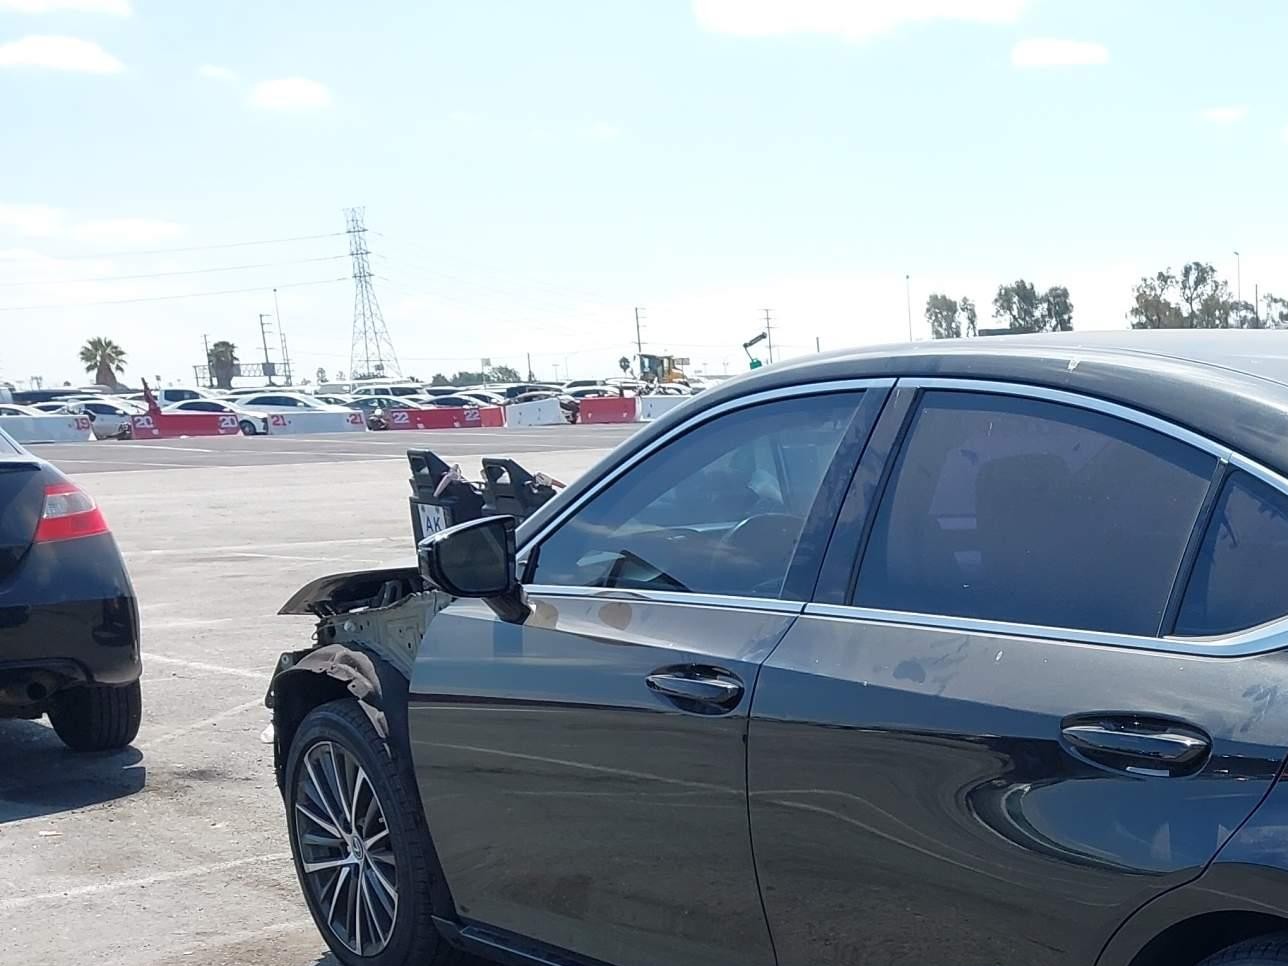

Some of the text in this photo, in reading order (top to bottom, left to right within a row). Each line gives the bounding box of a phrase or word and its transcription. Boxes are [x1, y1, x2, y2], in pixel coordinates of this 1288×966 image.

[271, 415, 287, 426] 21
[348, 413, 364, 425] 21
[392, 411, 410, 424] 22
[464, 409, 481, 421] 22
[75, 417, 90, 430] 19
[133, 415, 154, 428] 20
[219, 416, 238, 428] 20
[426, 515, 442, 532] AK
